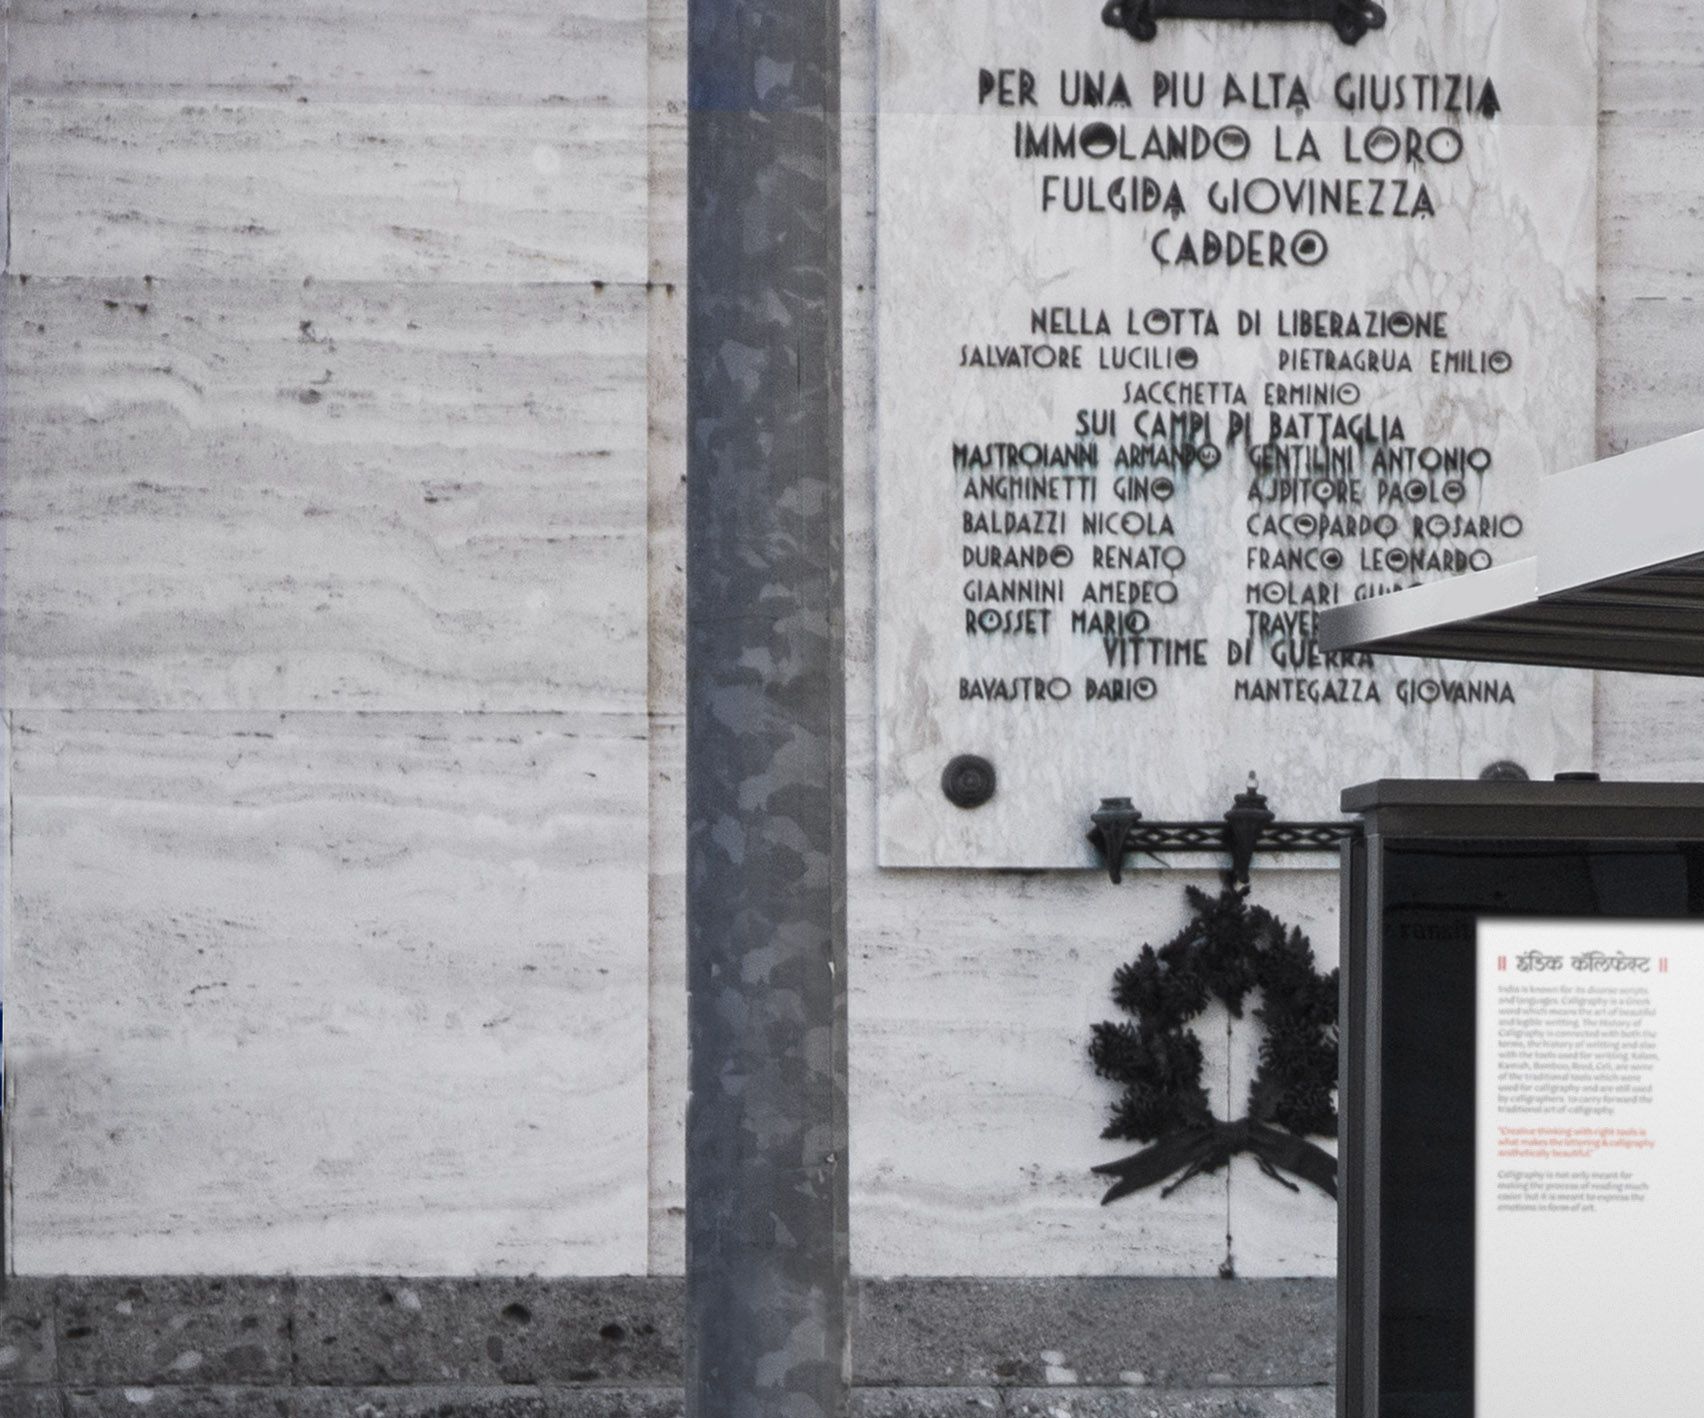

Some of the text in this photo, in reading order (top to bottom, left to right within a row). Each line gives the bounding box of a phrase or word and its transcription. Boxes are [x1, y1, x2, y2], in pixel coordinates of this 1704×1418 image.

[979, 69, 1502, 116] PER UNA PIU ALTA GIUSTIZIA
[1015, 121, 1464, 165] IMMOLANDO LA LORO
[1042, 175, 1436, 218] FULGIDA GIOVINEZZA
[1151, 228, 1329, 268] CADDERO
[1030, 307, 1448, 339] NELLA LOTTA DI LIBERAZIONE
[960, 344, 1200, 370] SALVATORE LUCILIO
[1279, 347, 1513, 375] PIETRAGRUA EMILIO
[1122, 381, 1361, 406] SACCHETTA ERMINIO
[1075, 409, 1406, 443] SUI CAMPI DI BATTAGLIA
[952, 443, 1221, 471] MASTROIANNI ARMANDO
[1247, 445, 1492, 473] GENTILINI ANTONIO
[963, 476, 1175, 501] ANGHINETTI GINO
[1378, 479, 1467, 503] PAOLO
[963, 510, 1175, 535] BALDAZZI NICOLA
[1247, 513, 1523, 539] CACOPARDO ROSARIO
[963, 545, 1186, 570] DURANDO RENATO
[1247, 547, 1492, 573] FRANCO LEONARDO
[963, 579, 1178, 604] GIANNINI AMEDEO
[1246, 581, 1339, 605] MOLARI
[965, 608, 1150, 634] ROSSET MARIO
[1103, 637, 1207, 667] VITTIME
[1227, 638, 1252, 667] DI
[959, 677, 1158, 702] BAVASTRO DARIO
[1234, 678, 1516, 704] MANTEGAZZA GIOVANNA
